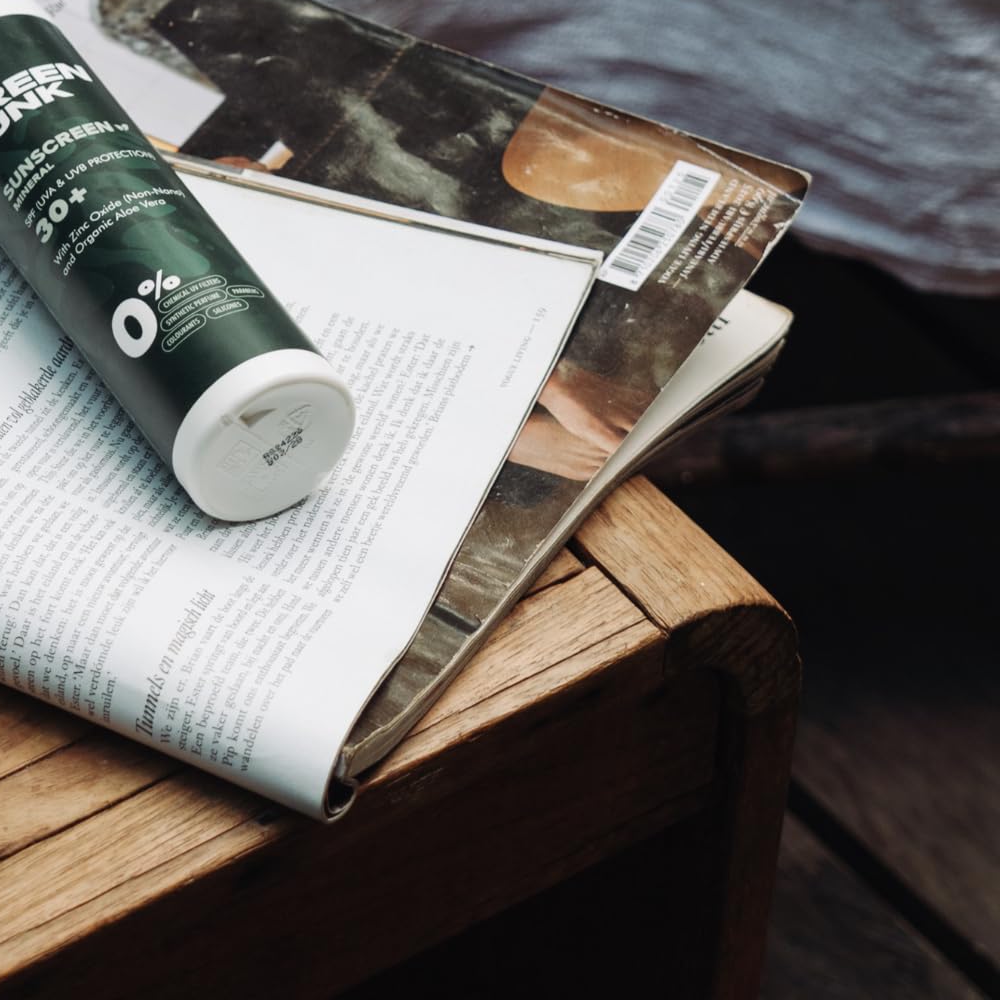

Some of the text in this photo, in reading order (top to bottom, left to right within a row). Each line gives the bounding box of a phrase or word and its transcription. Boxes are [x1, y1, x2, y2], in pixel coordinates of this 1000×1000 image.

[3, 120, 115, 201] SUNSCREEN
[12, 162, 55, 212] MINERAL
[24, 209, 37, 228] SPF
[35, 186, 57, 211] (UVA
[56, 179, 65, 189] &
[65, 164, 87, 180] UVB
[35, 187, 87, 244] 30+
[53, 242, 71, 265] With
[68, 221, 90, 242] Zinc
[90, 200, 122, 222] Oxide
[63, 198, 166, 276] and Organic Aloe Vera
[112, 269, 181, 358] 0%
[163, 289, 190, 308] CHEMICAL
[166, 304, 194, 326] SYNTHETIC
[212, 301, 242, 314] SILICONES
[167, 318, 200, 346] COLOURANTS
[134, 586, 215, 737] Tunnels en magisch licht
[222, 744, 238, 767] Pip
[241, 713, 264, 772] wandelen
